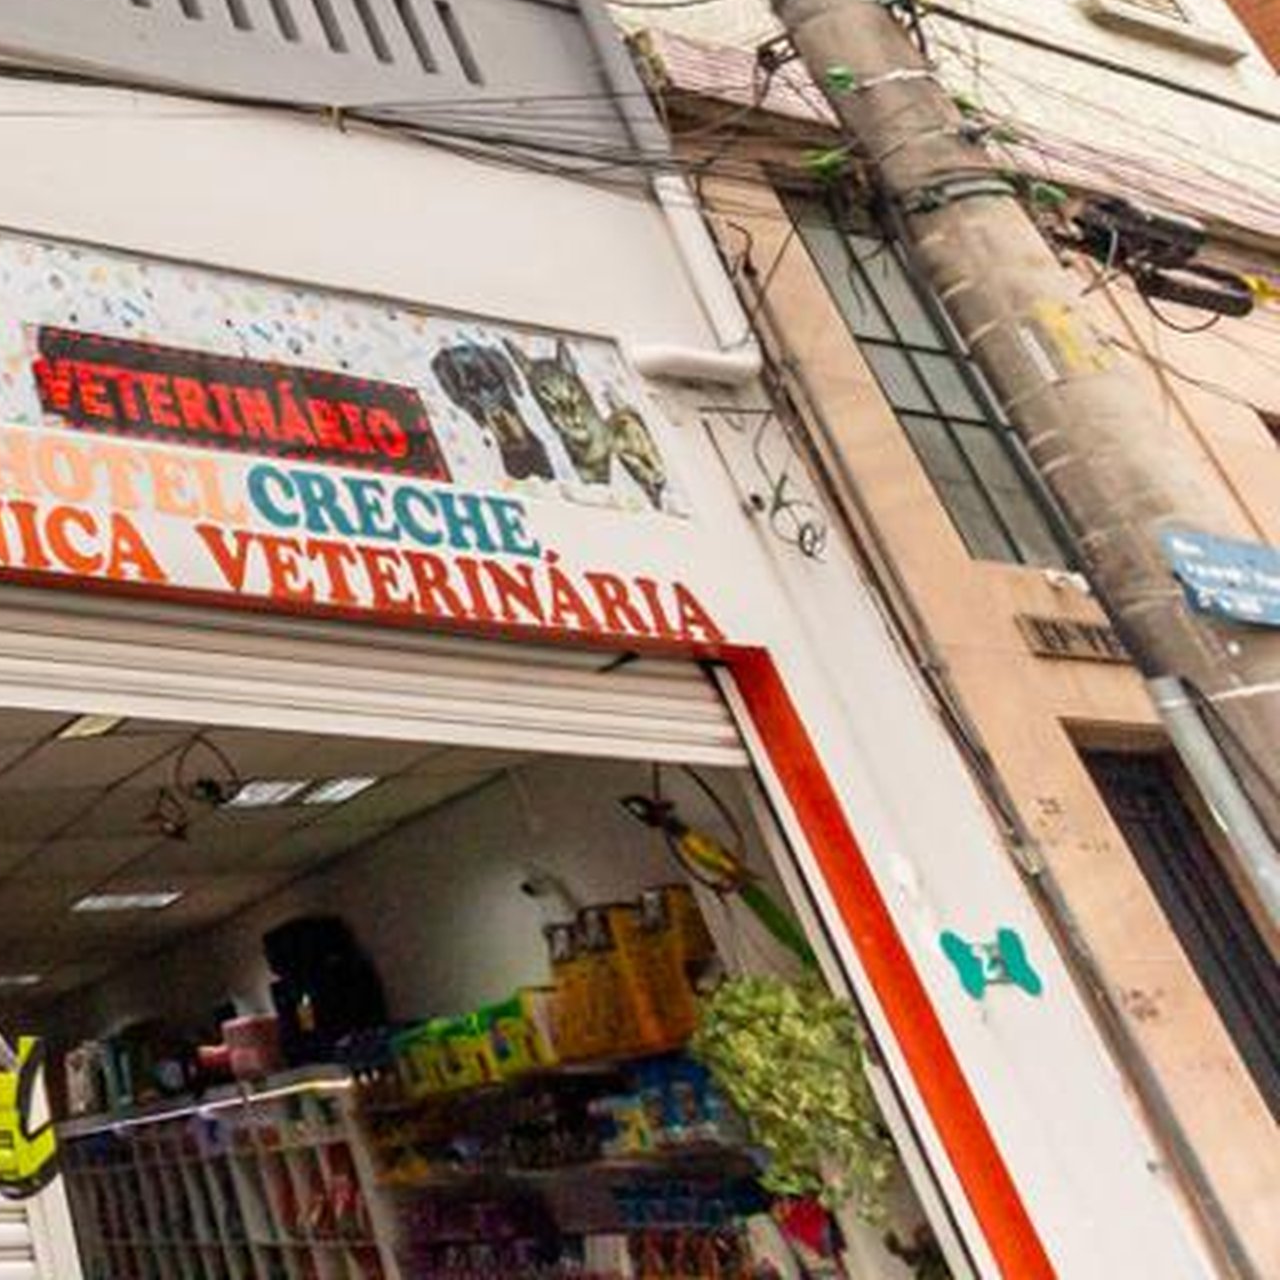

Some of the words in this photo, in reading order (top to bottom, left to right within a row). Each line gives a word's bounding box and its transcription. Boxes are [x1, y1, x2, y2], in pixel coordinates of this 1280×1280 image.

[31, 356, 409, 459] VETERINÁRIO
[246, 462, 541, 559] CRECHE
[196, 522, 727, 643] VETERINÁRIA
